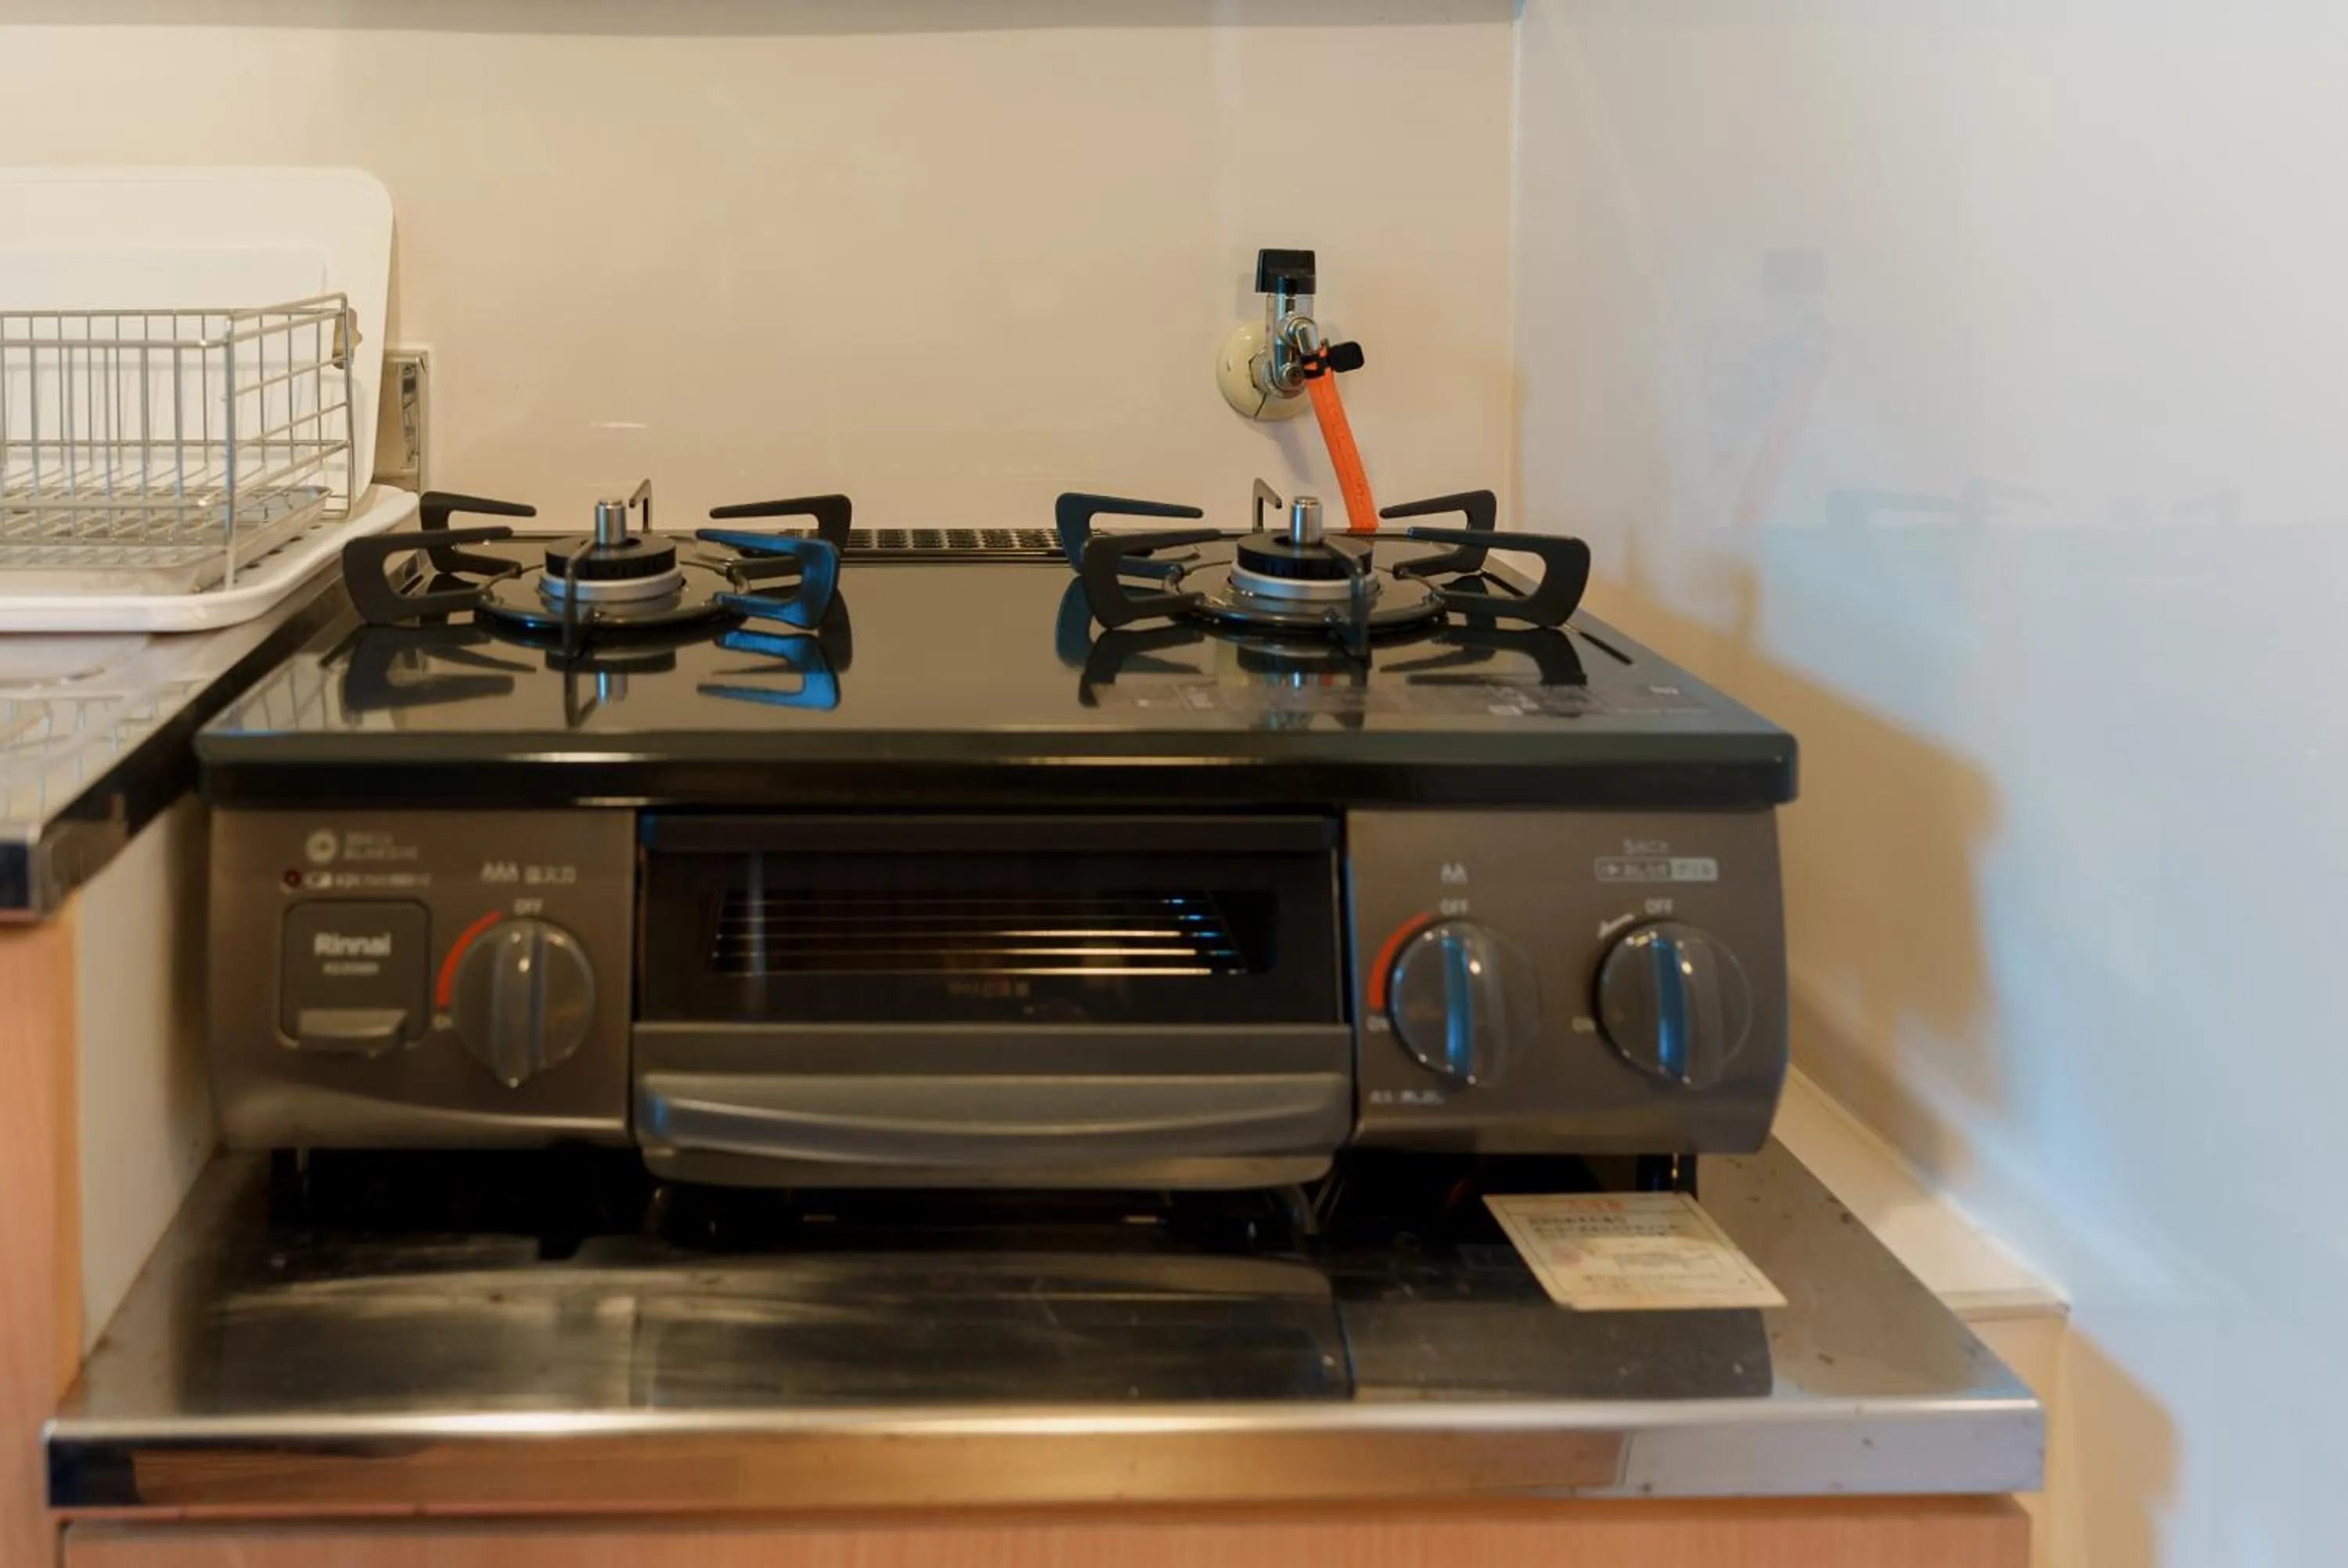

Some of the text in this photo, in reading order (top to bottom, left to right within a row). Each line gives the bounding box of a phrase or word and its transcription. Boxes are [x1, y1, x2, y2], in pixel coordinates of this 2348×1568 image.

[513, 898, 543, 915] OFF
[1440, 899, 1468, 915] OFF
[315, 931, 391, 955] Rinnai
